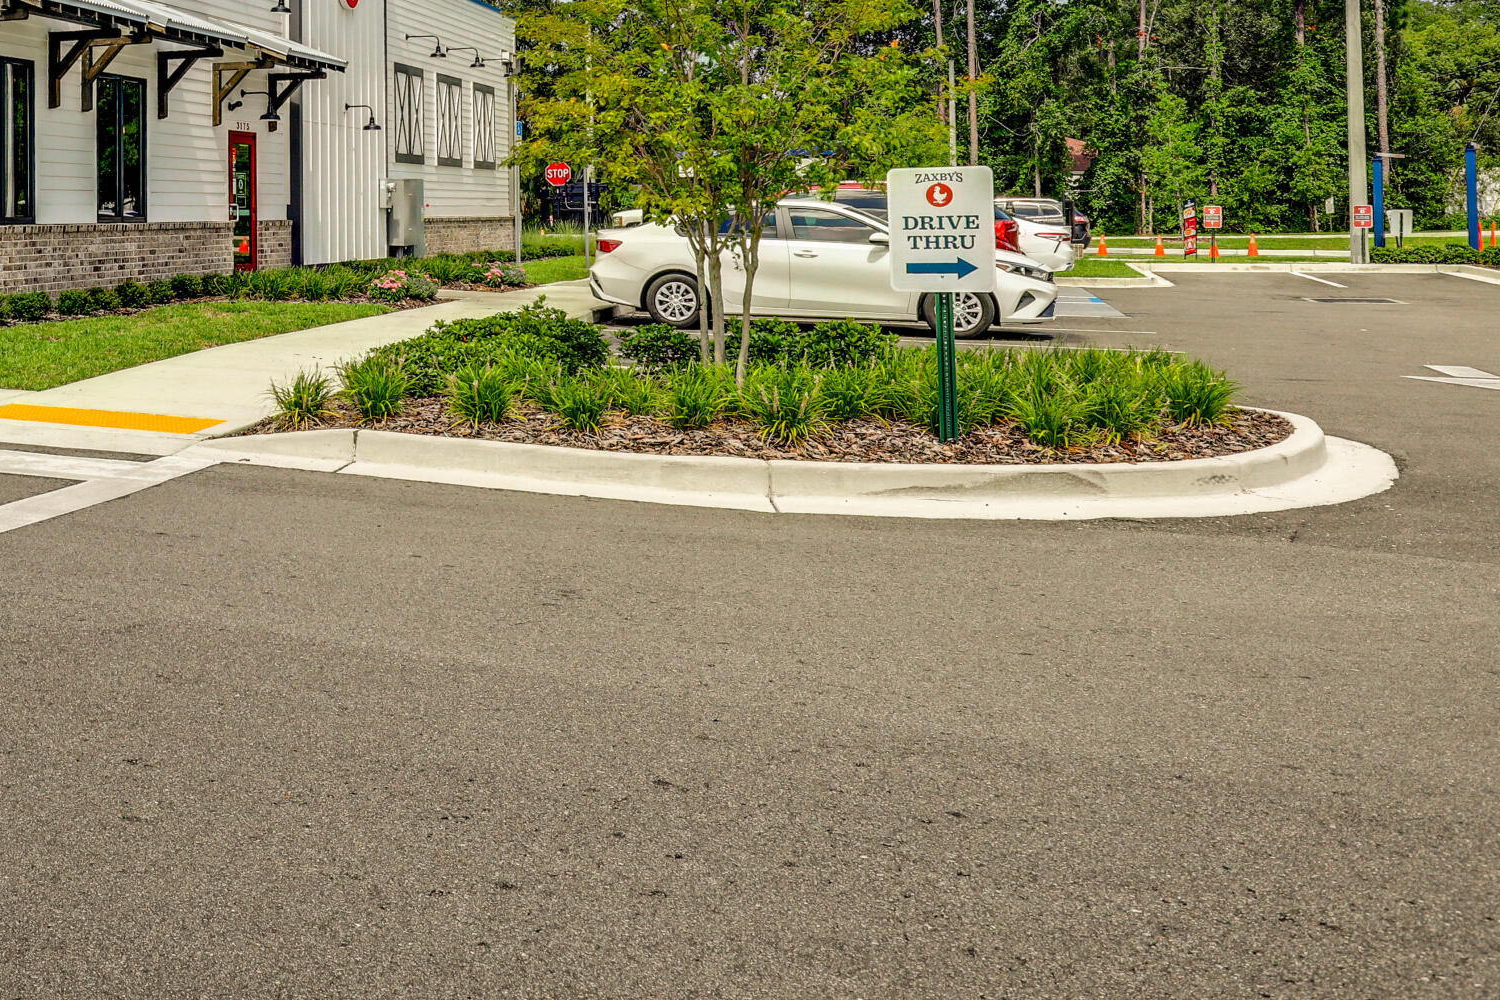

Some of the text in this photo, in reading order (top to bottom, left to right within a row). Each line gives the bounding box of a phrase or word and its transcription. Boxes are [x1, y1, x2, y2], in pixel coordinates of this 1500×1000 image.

[547, 168, 569, 178] STOP
[915, 171, 963, 184] ZAXBY'S
[902, 215, 980, 230] DRIVE
[907, 235, 976, 250] THRU
